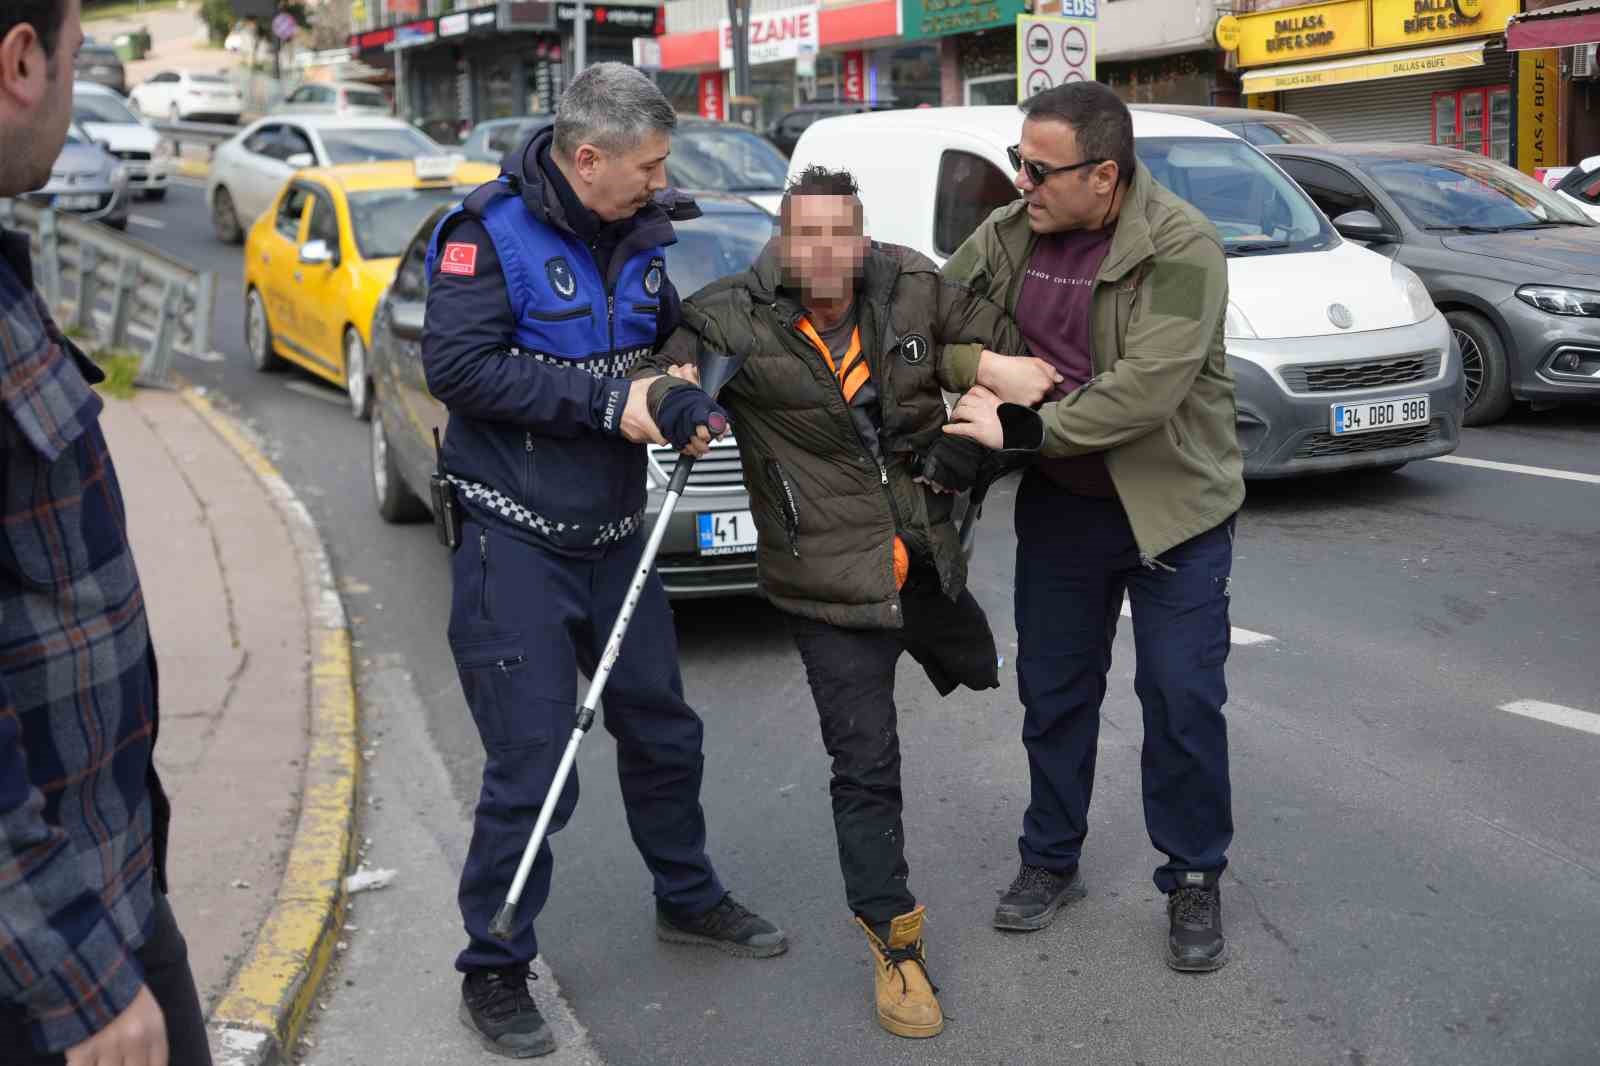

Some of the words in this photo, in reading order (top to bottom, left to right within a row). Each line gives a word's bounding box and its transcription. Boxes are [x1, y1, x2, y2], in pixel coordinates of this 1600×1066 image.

[1063, 0, 1096, 16] EDS
[1436, 12, 1446, 29] &
[1393, 60, 1420, 73] DALLAS
[1534, 112, 1545, 123] 4
[603, 391, 620, 431] ZABITA
[1344, 408, 1361, 429] 34
[1369, 404, 1395, 426] DBD
[1402, 400, 1426, 422] 988
[714, 515, 739, 543] 41
